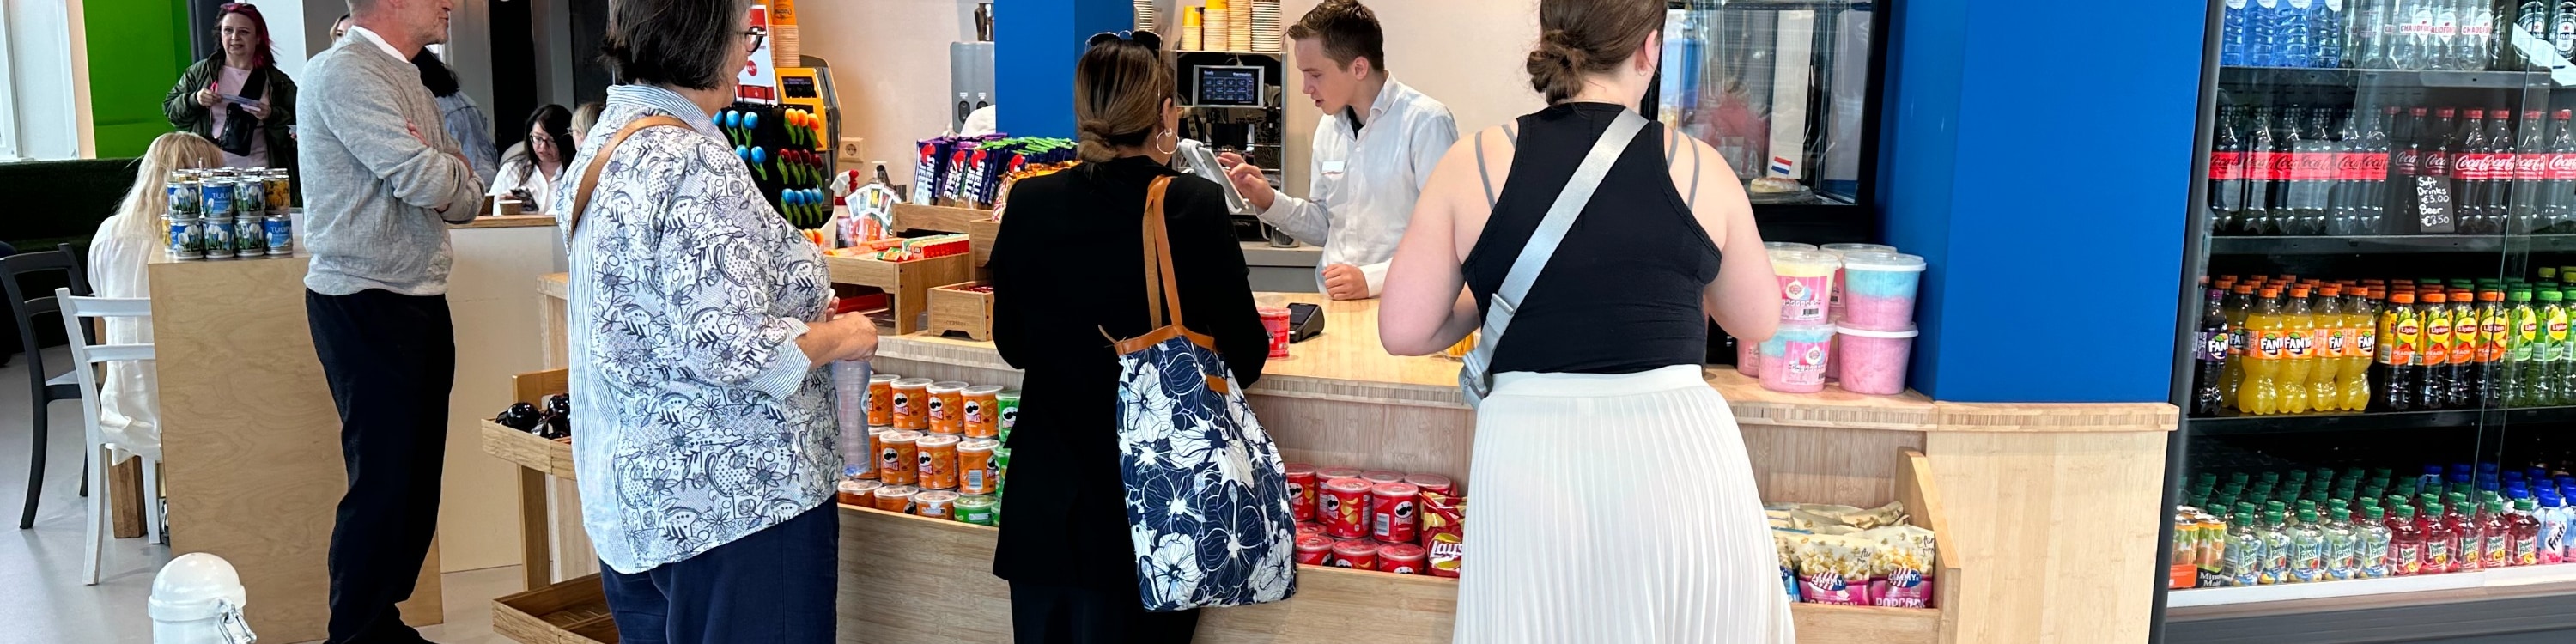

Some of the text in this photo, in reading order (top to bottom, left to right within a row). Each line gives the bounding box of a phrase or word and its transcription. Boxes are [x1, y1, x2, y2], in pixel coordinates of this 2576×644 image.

[963, 166, 975, 199] JELLE
[971, 160, 986, 202] SNELLE
[2418, 176, 2437, 189] Soft
[2417, 186, 2447, 196] Drinks
[2419, 204, 2443, 215] Beer
[2229, 333, 2245, 345] FA
[2547, 520, 2566, 551] Fristi
